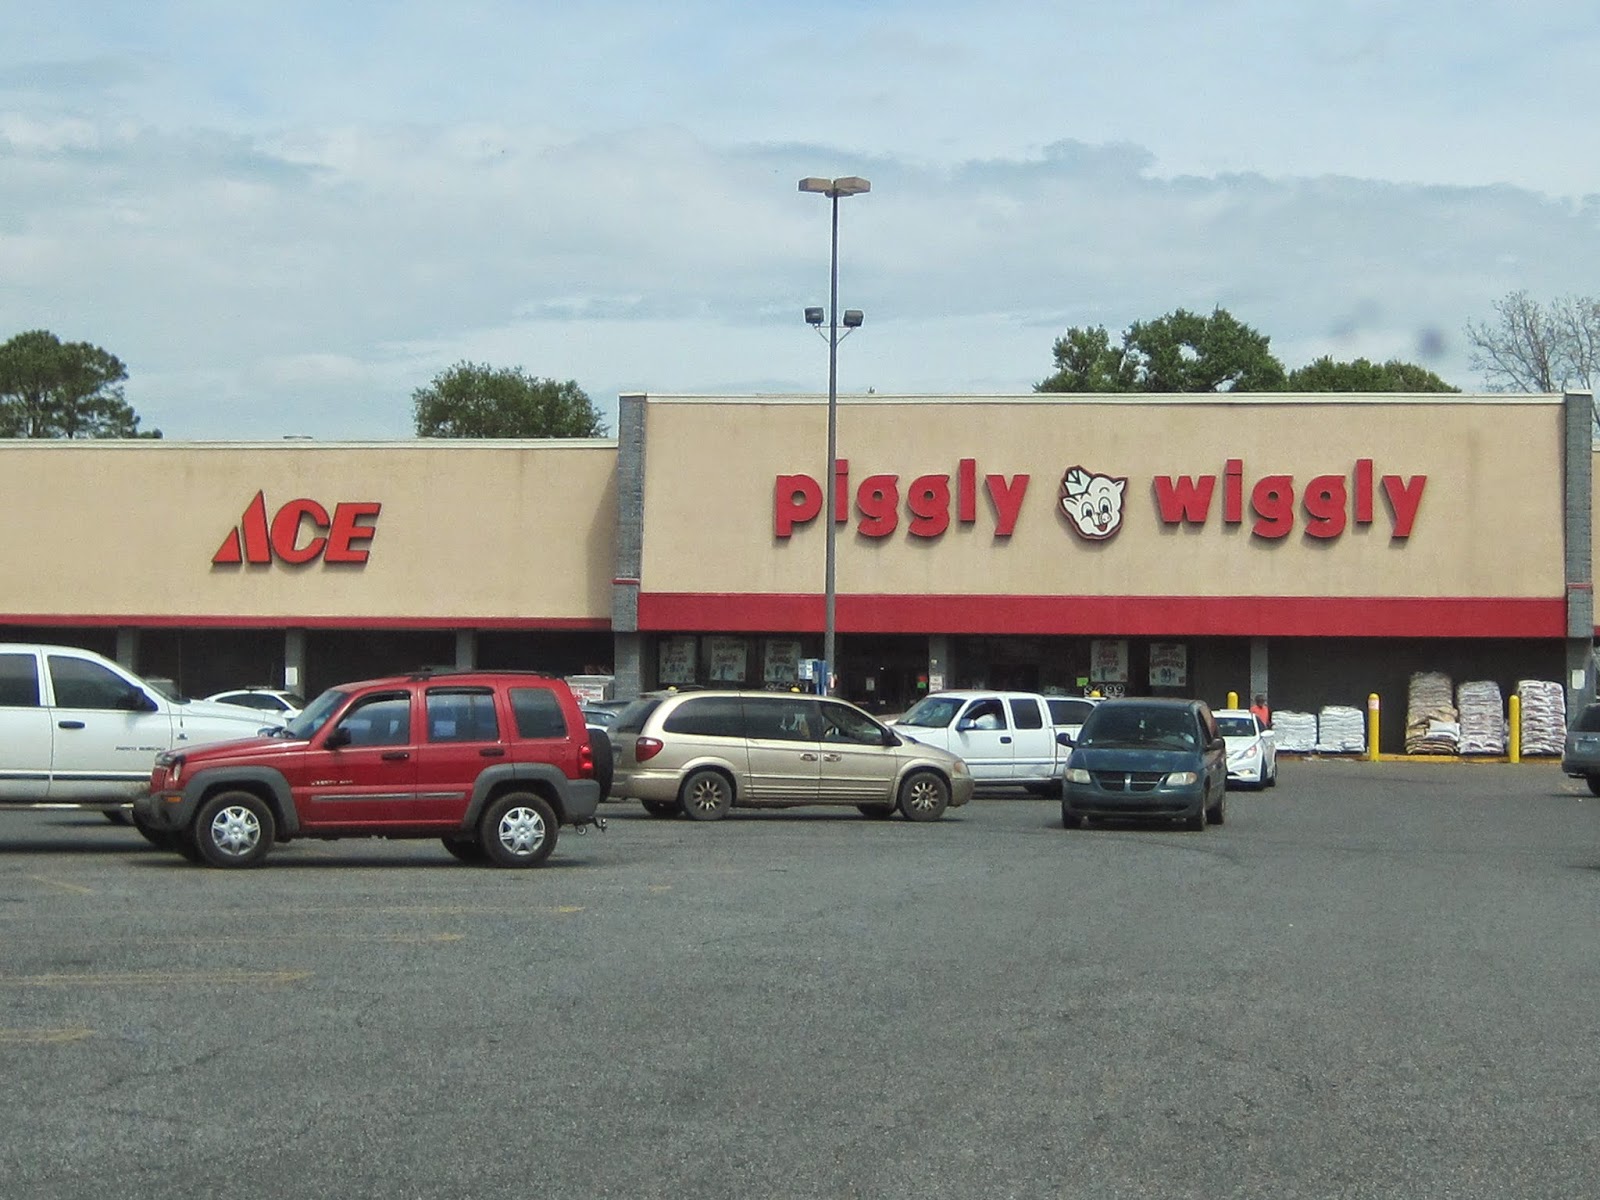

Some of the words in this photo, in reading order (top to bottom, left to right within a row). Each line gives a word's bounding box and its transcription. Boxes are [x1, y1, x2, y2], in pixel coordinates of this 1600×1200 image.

[211, 489, 382, 564] ACE
[775, 458, 1031, 538] piggly
[1154, 459, 1427, 538] wiggly
